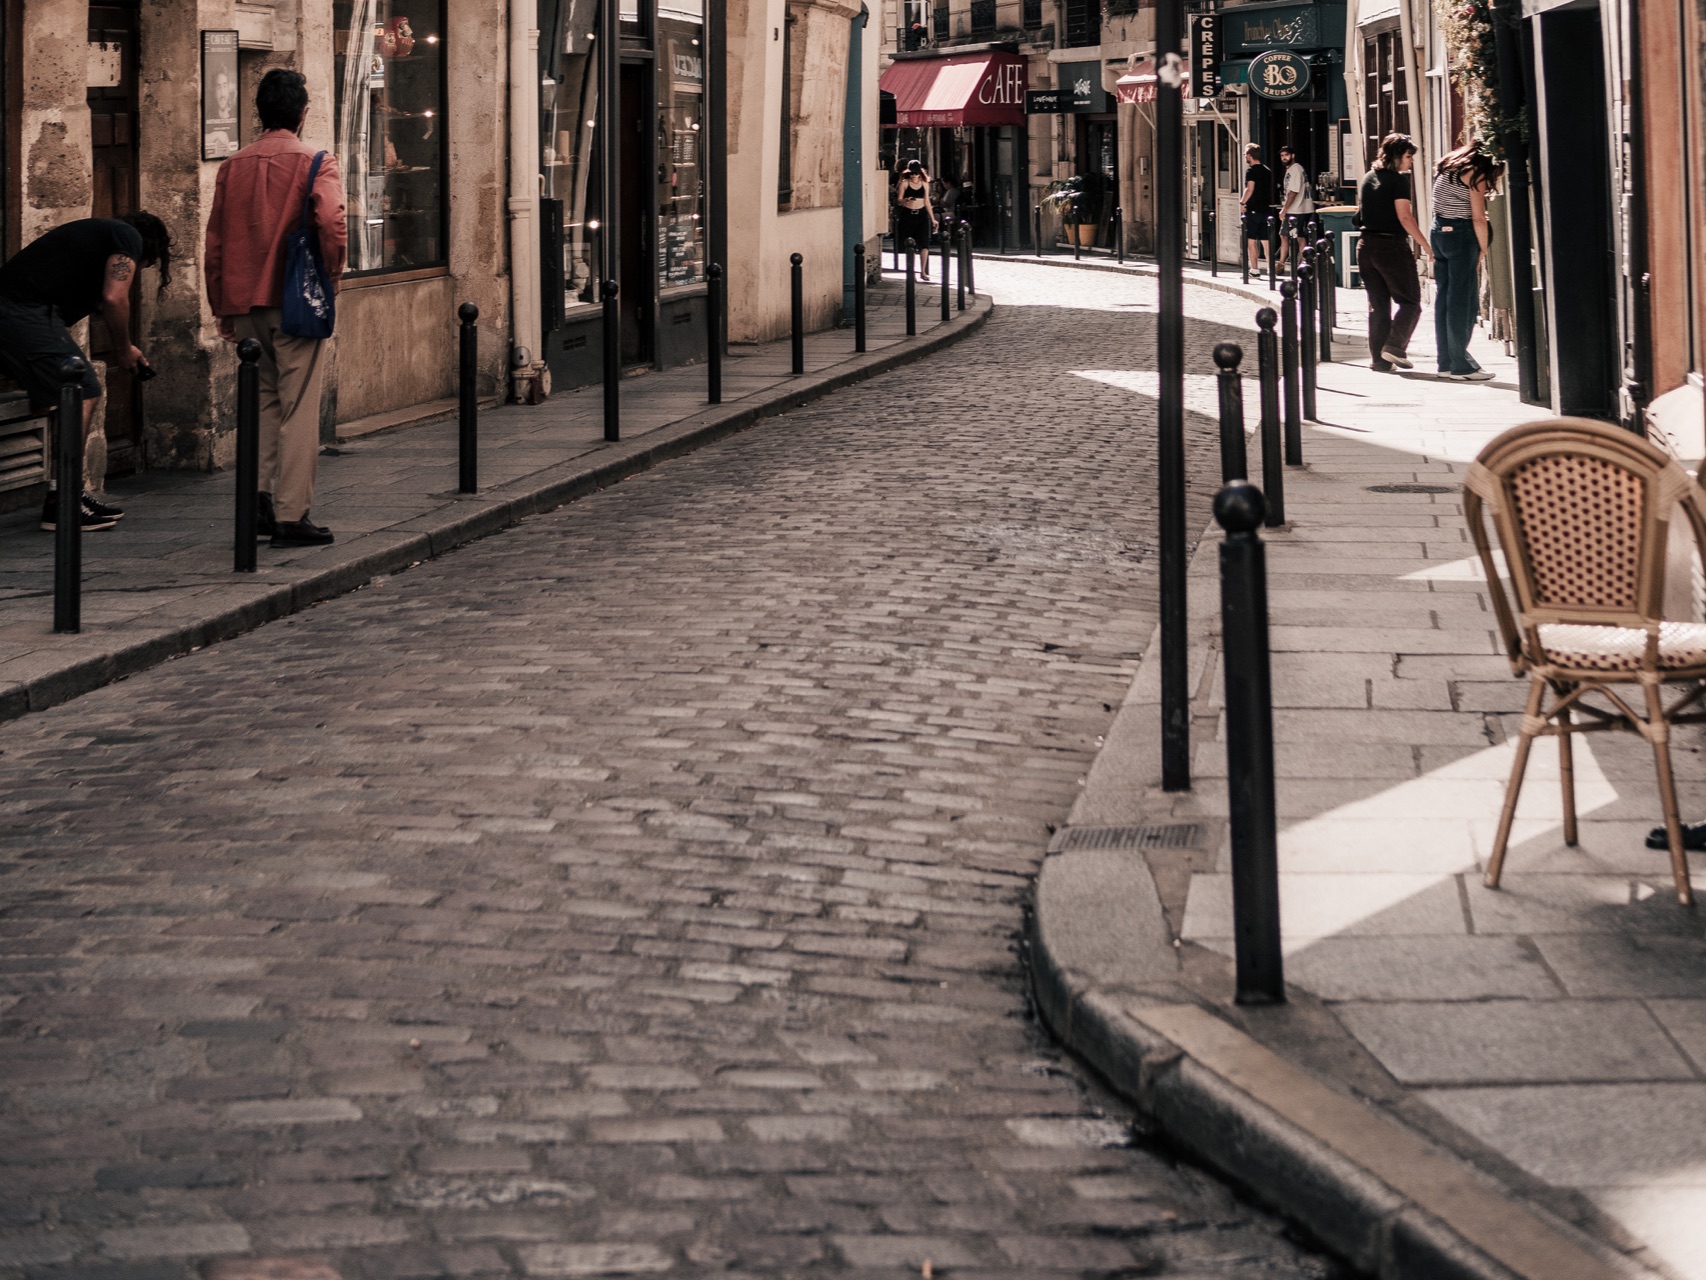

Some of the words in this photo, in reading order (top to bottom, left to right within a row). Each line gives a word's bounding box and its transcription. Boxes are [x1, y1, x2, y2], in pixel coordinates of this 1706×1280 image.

[1201, 17, 1214, 96] CRÊPES
[1264, 54, 1292, 63] COFFEE
[979, 64, 1023, 105] CAFE
[1263, 85, 1298, 96] BRUNCH
